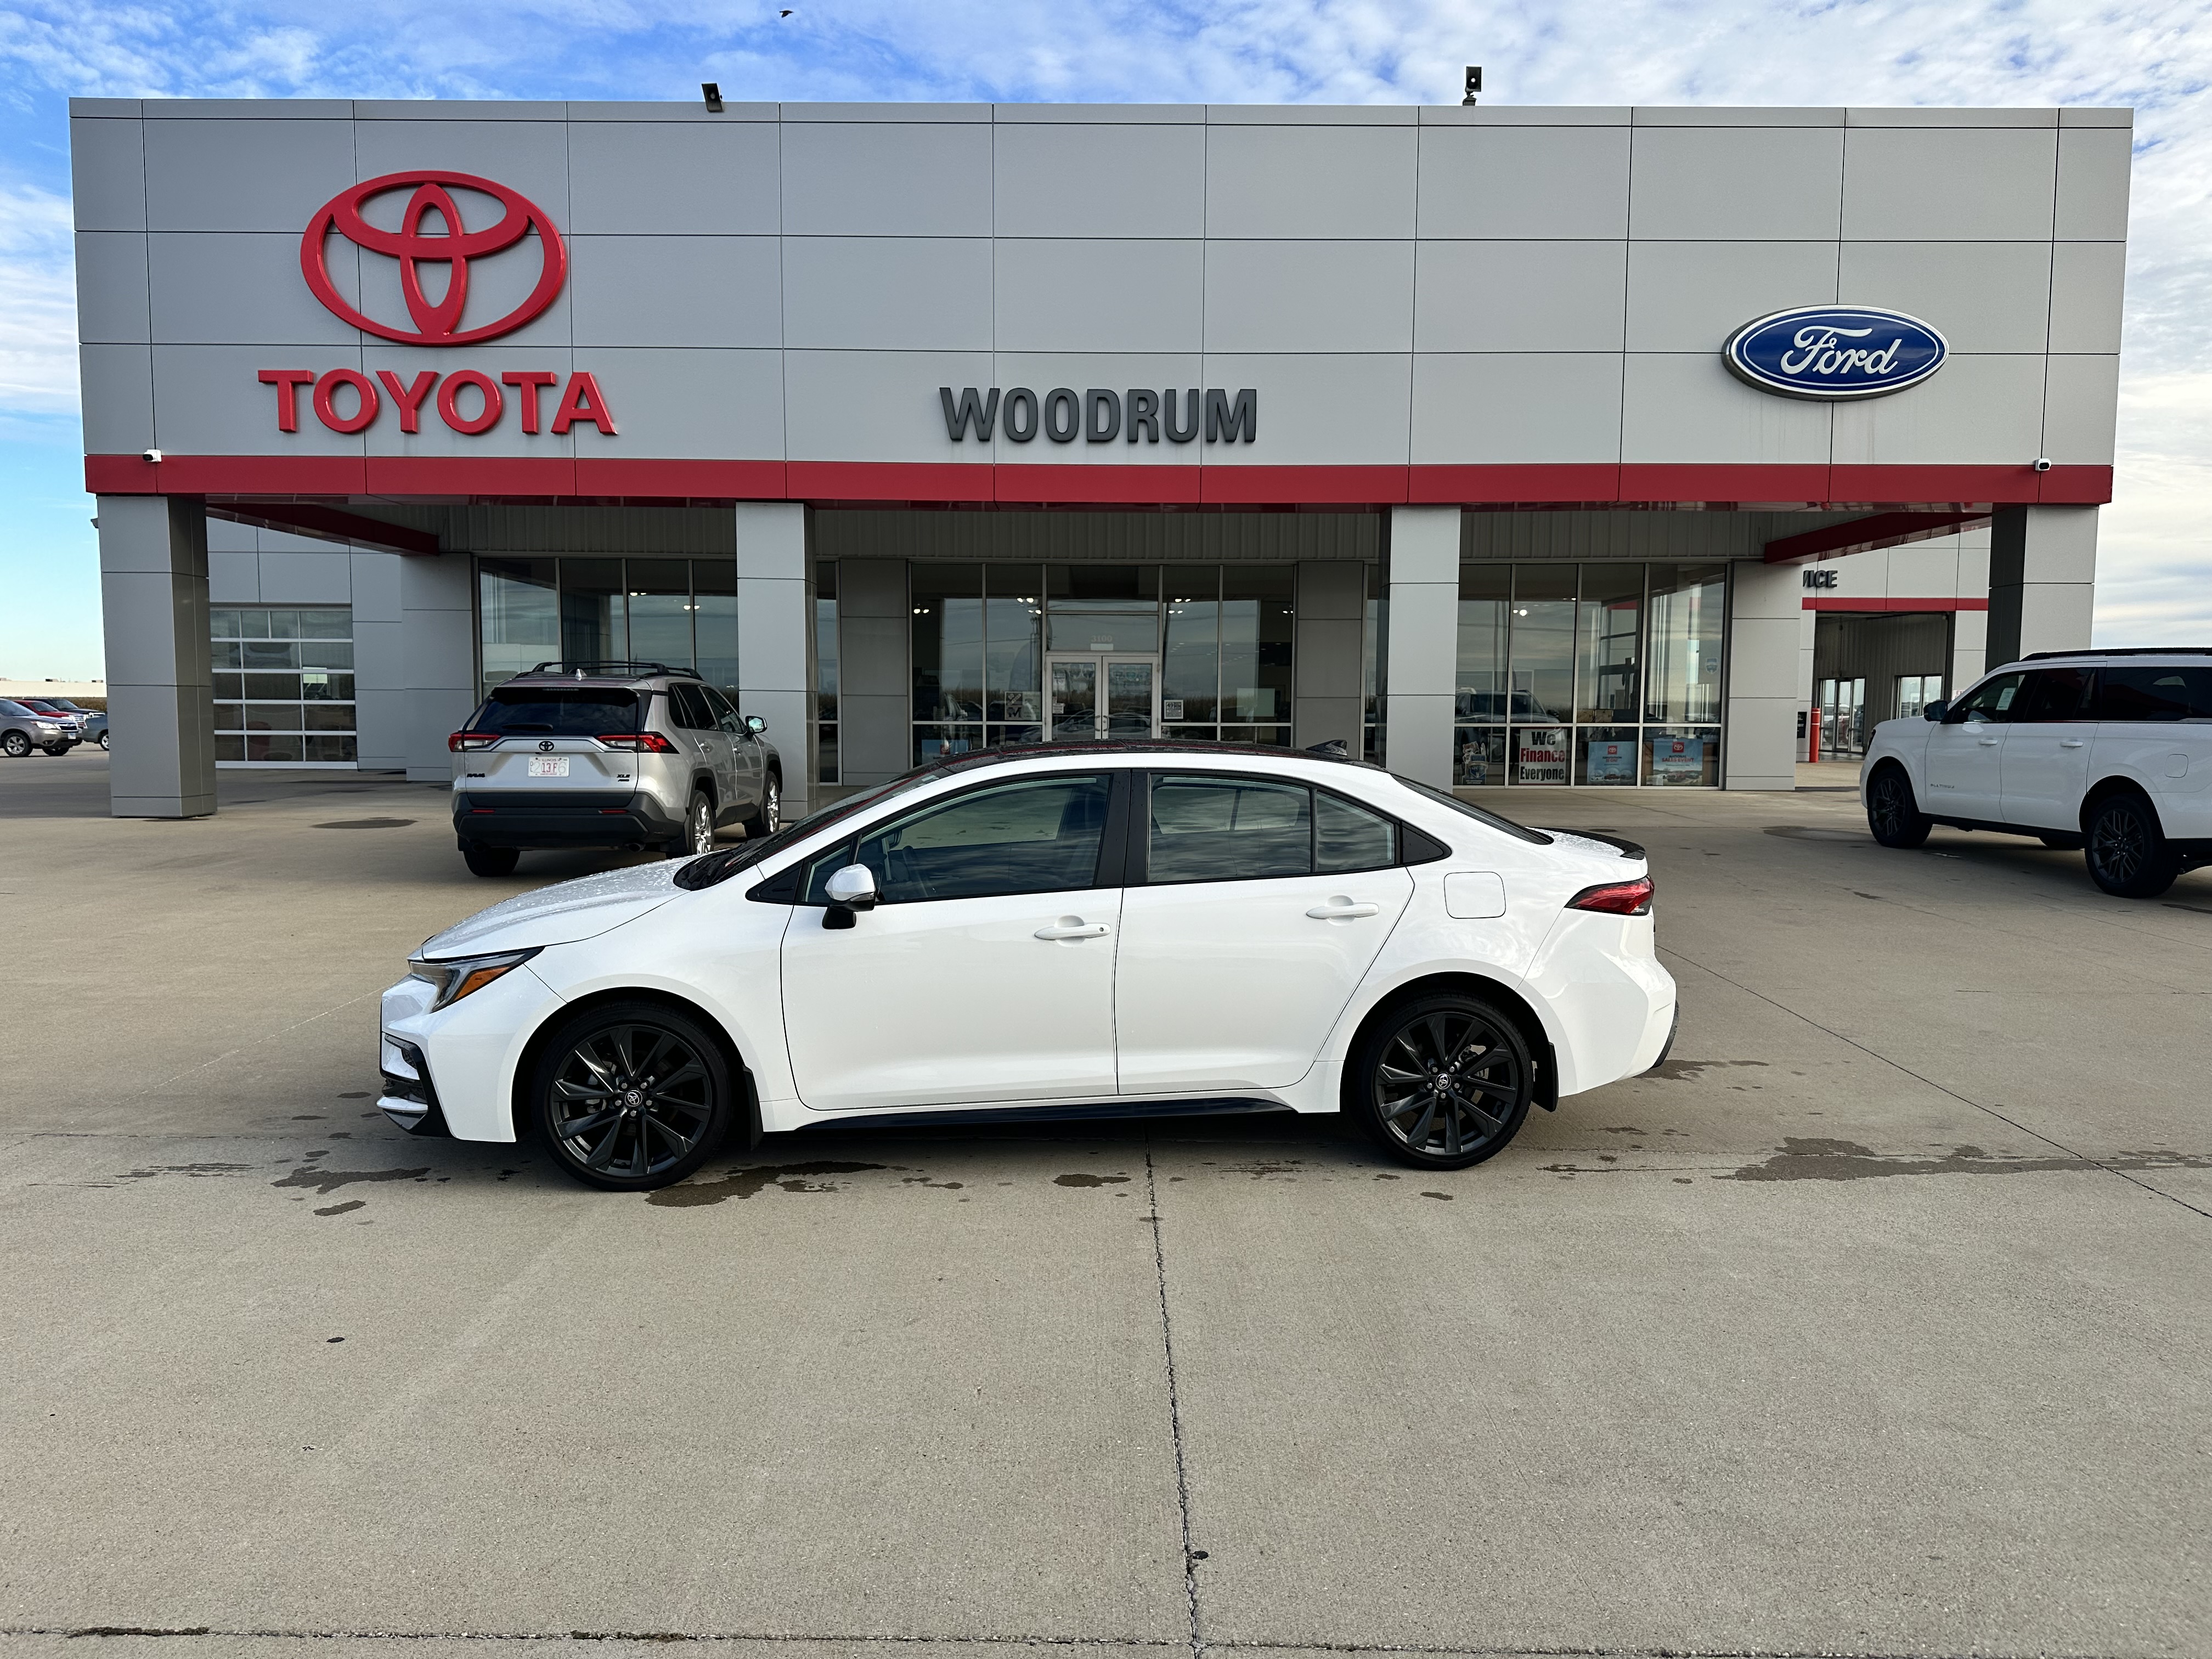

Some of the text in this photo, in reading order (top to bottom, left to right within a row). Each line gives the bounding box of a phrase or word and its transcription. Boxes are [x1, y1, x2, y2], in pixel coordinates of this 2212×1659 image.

[1780, 325, 1903, 375] Ford
[258, 369, 618, 435] TOYOTA
[939, 387, 1257, 443] WOODRUM
[1532, 731, 1556, 746] We
[1520, 748, 1565, 763] Finance
[1520, 766, 1565, 781] Everyone
